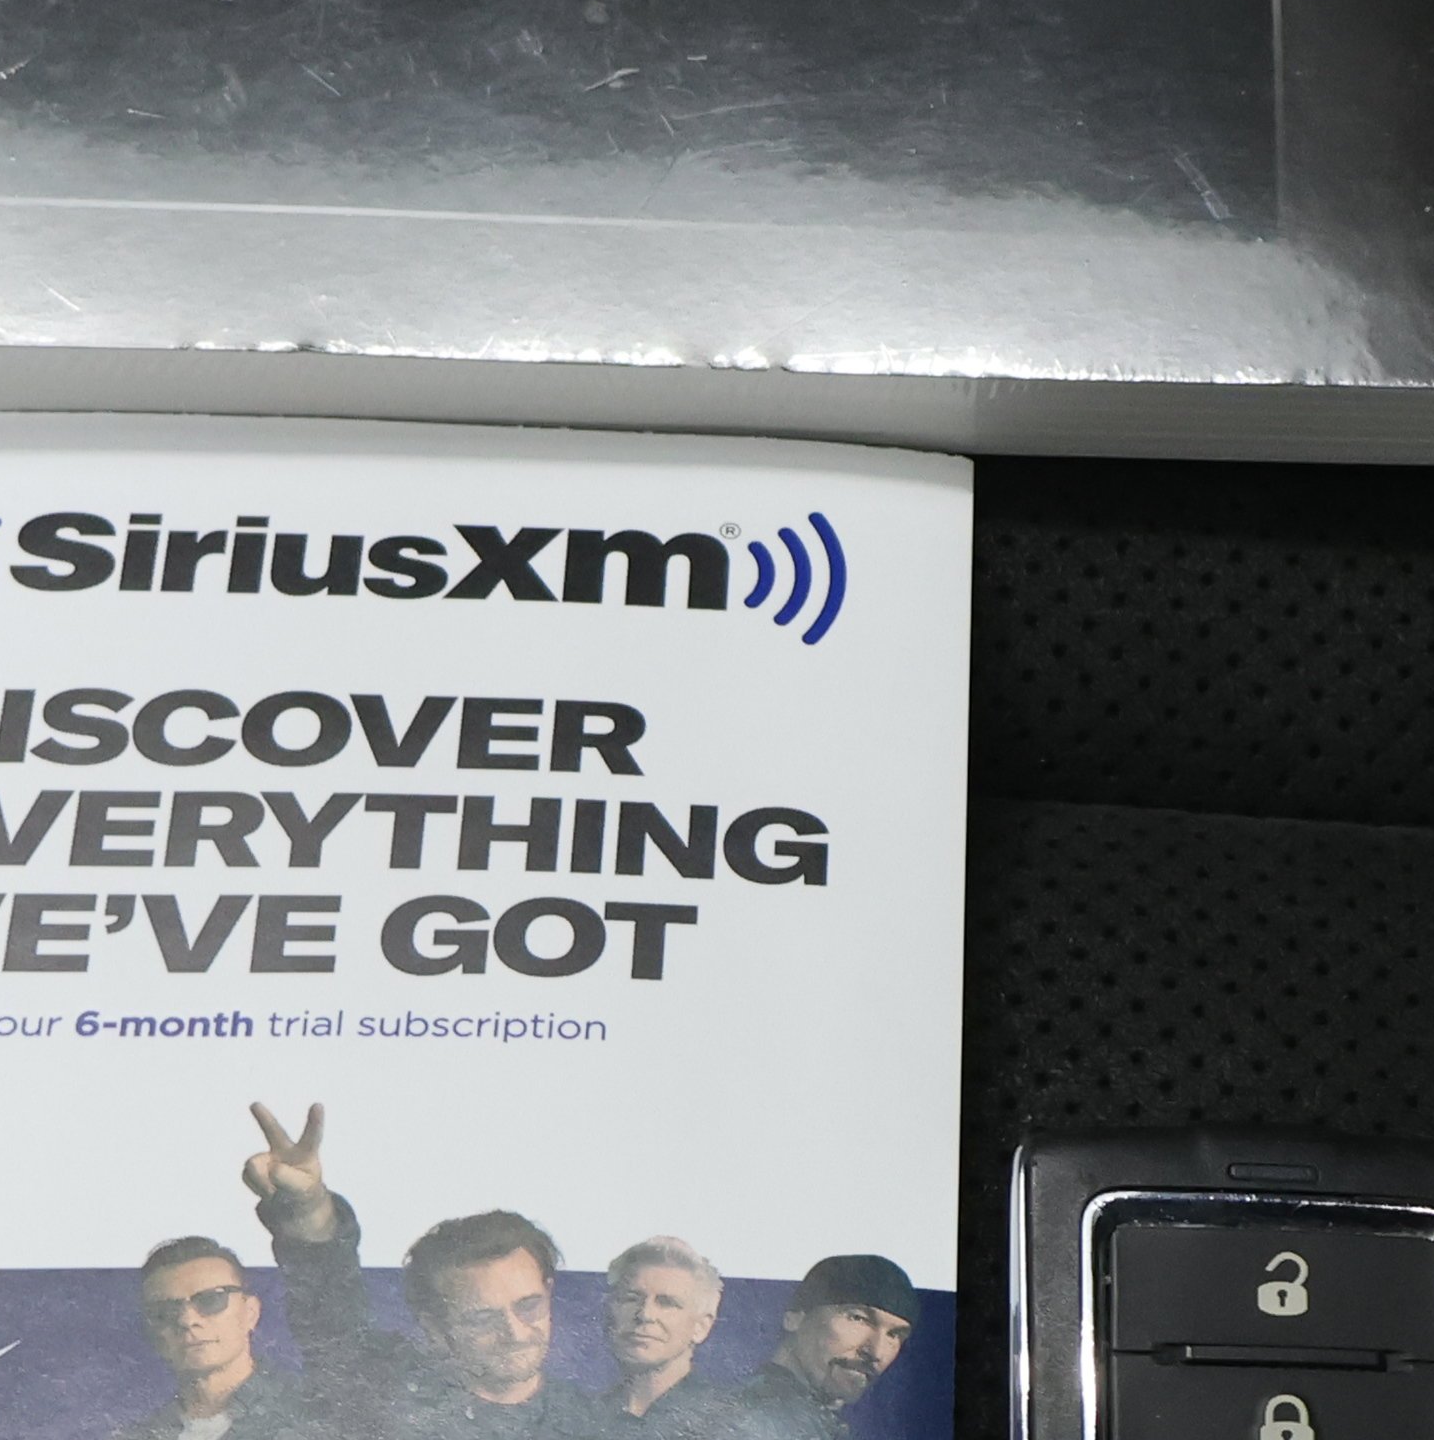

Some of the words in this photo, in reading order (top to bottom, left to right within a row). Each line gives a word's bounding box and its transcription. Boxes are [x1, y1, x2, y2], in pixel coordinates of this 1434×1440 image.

[379, 896, 697, 982] GOT
[74, 1010, 254, 1039] 6-month
[269, 1010, 343, 1038] trial
[356, 1010, 608, 1043] subscription
